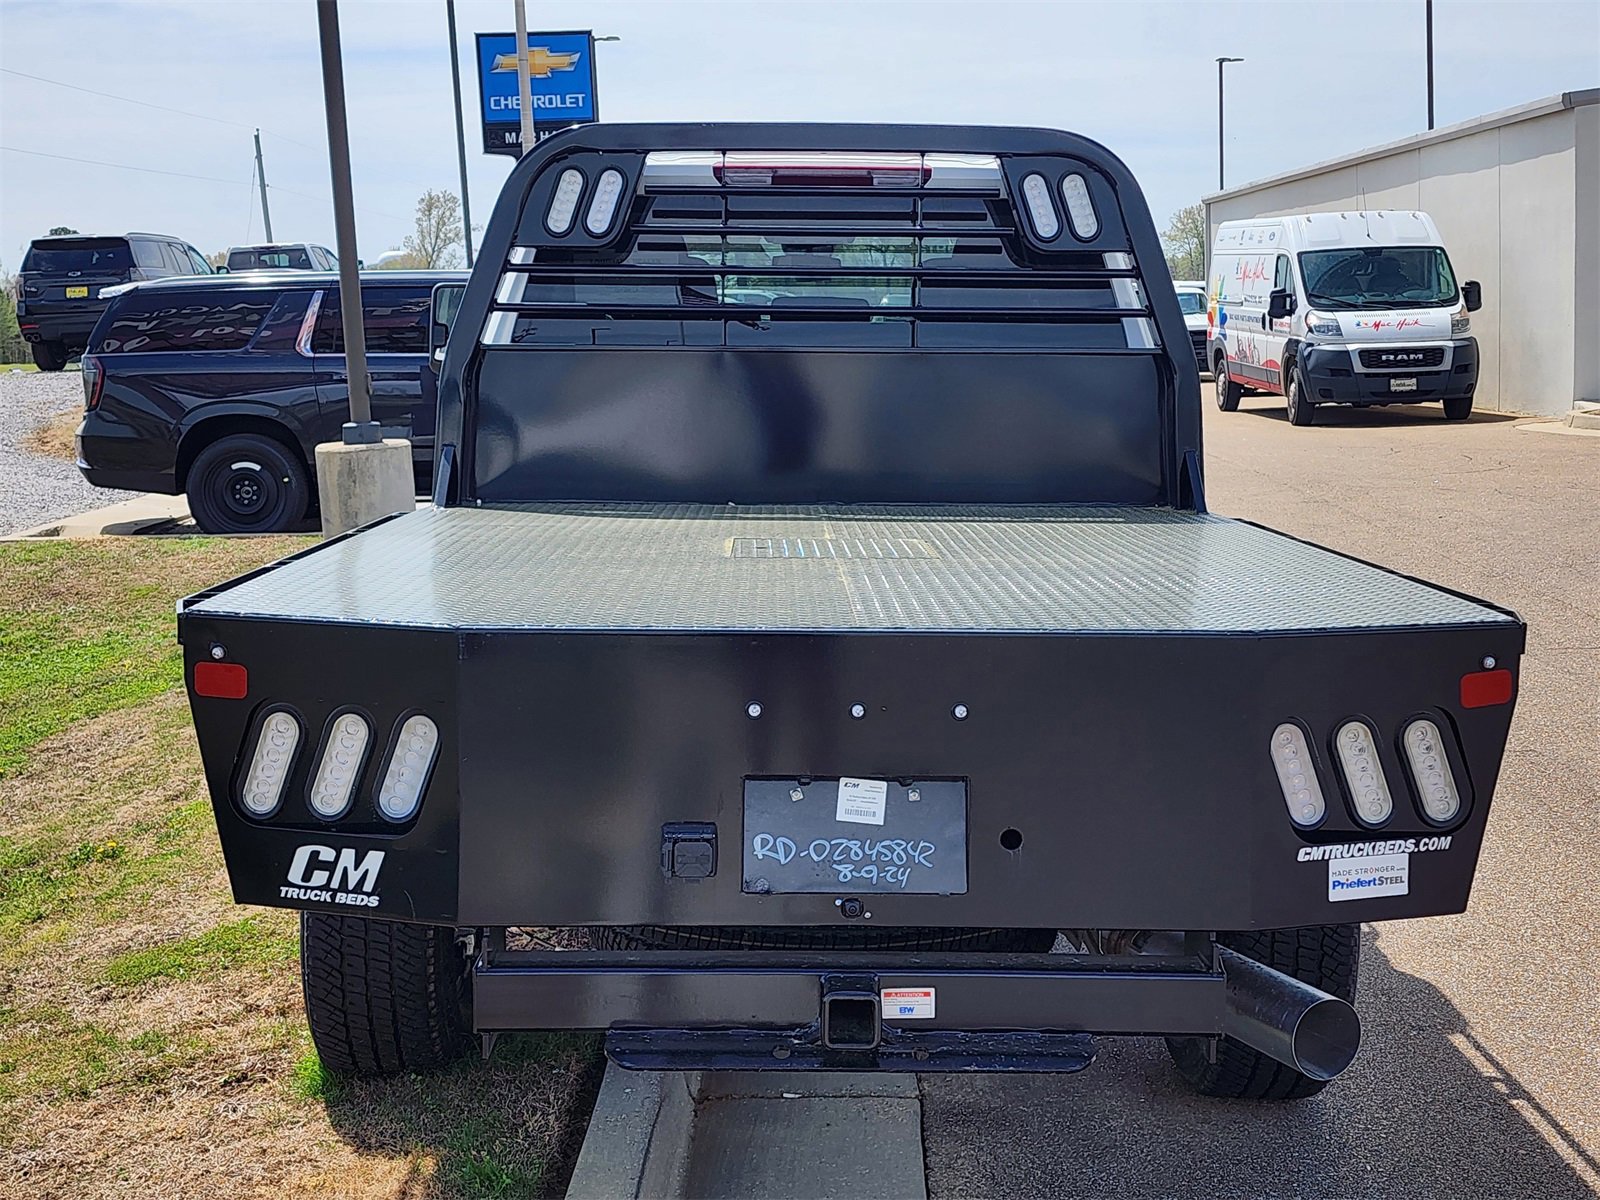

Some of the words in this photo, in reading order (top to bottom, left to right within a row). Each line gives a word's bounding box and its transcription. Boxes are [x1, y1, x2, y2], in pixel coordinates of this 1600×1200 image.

[490, 94, 586, 110] CHEROLET
[1381, 353, 1424, 361] RAM
[843, 781, 861, 789] CM
[1297, 836, 1452, 862] CMTRUCKBEDS.COM
[287, 845, 385, 892] CM
[1331, 869, 1353, 878] MADE
[1354, 865, 1396, 876] STRONGER
[280, 886, 333, 902] TRUCK
[334, 892, 380, 907] BEDS
